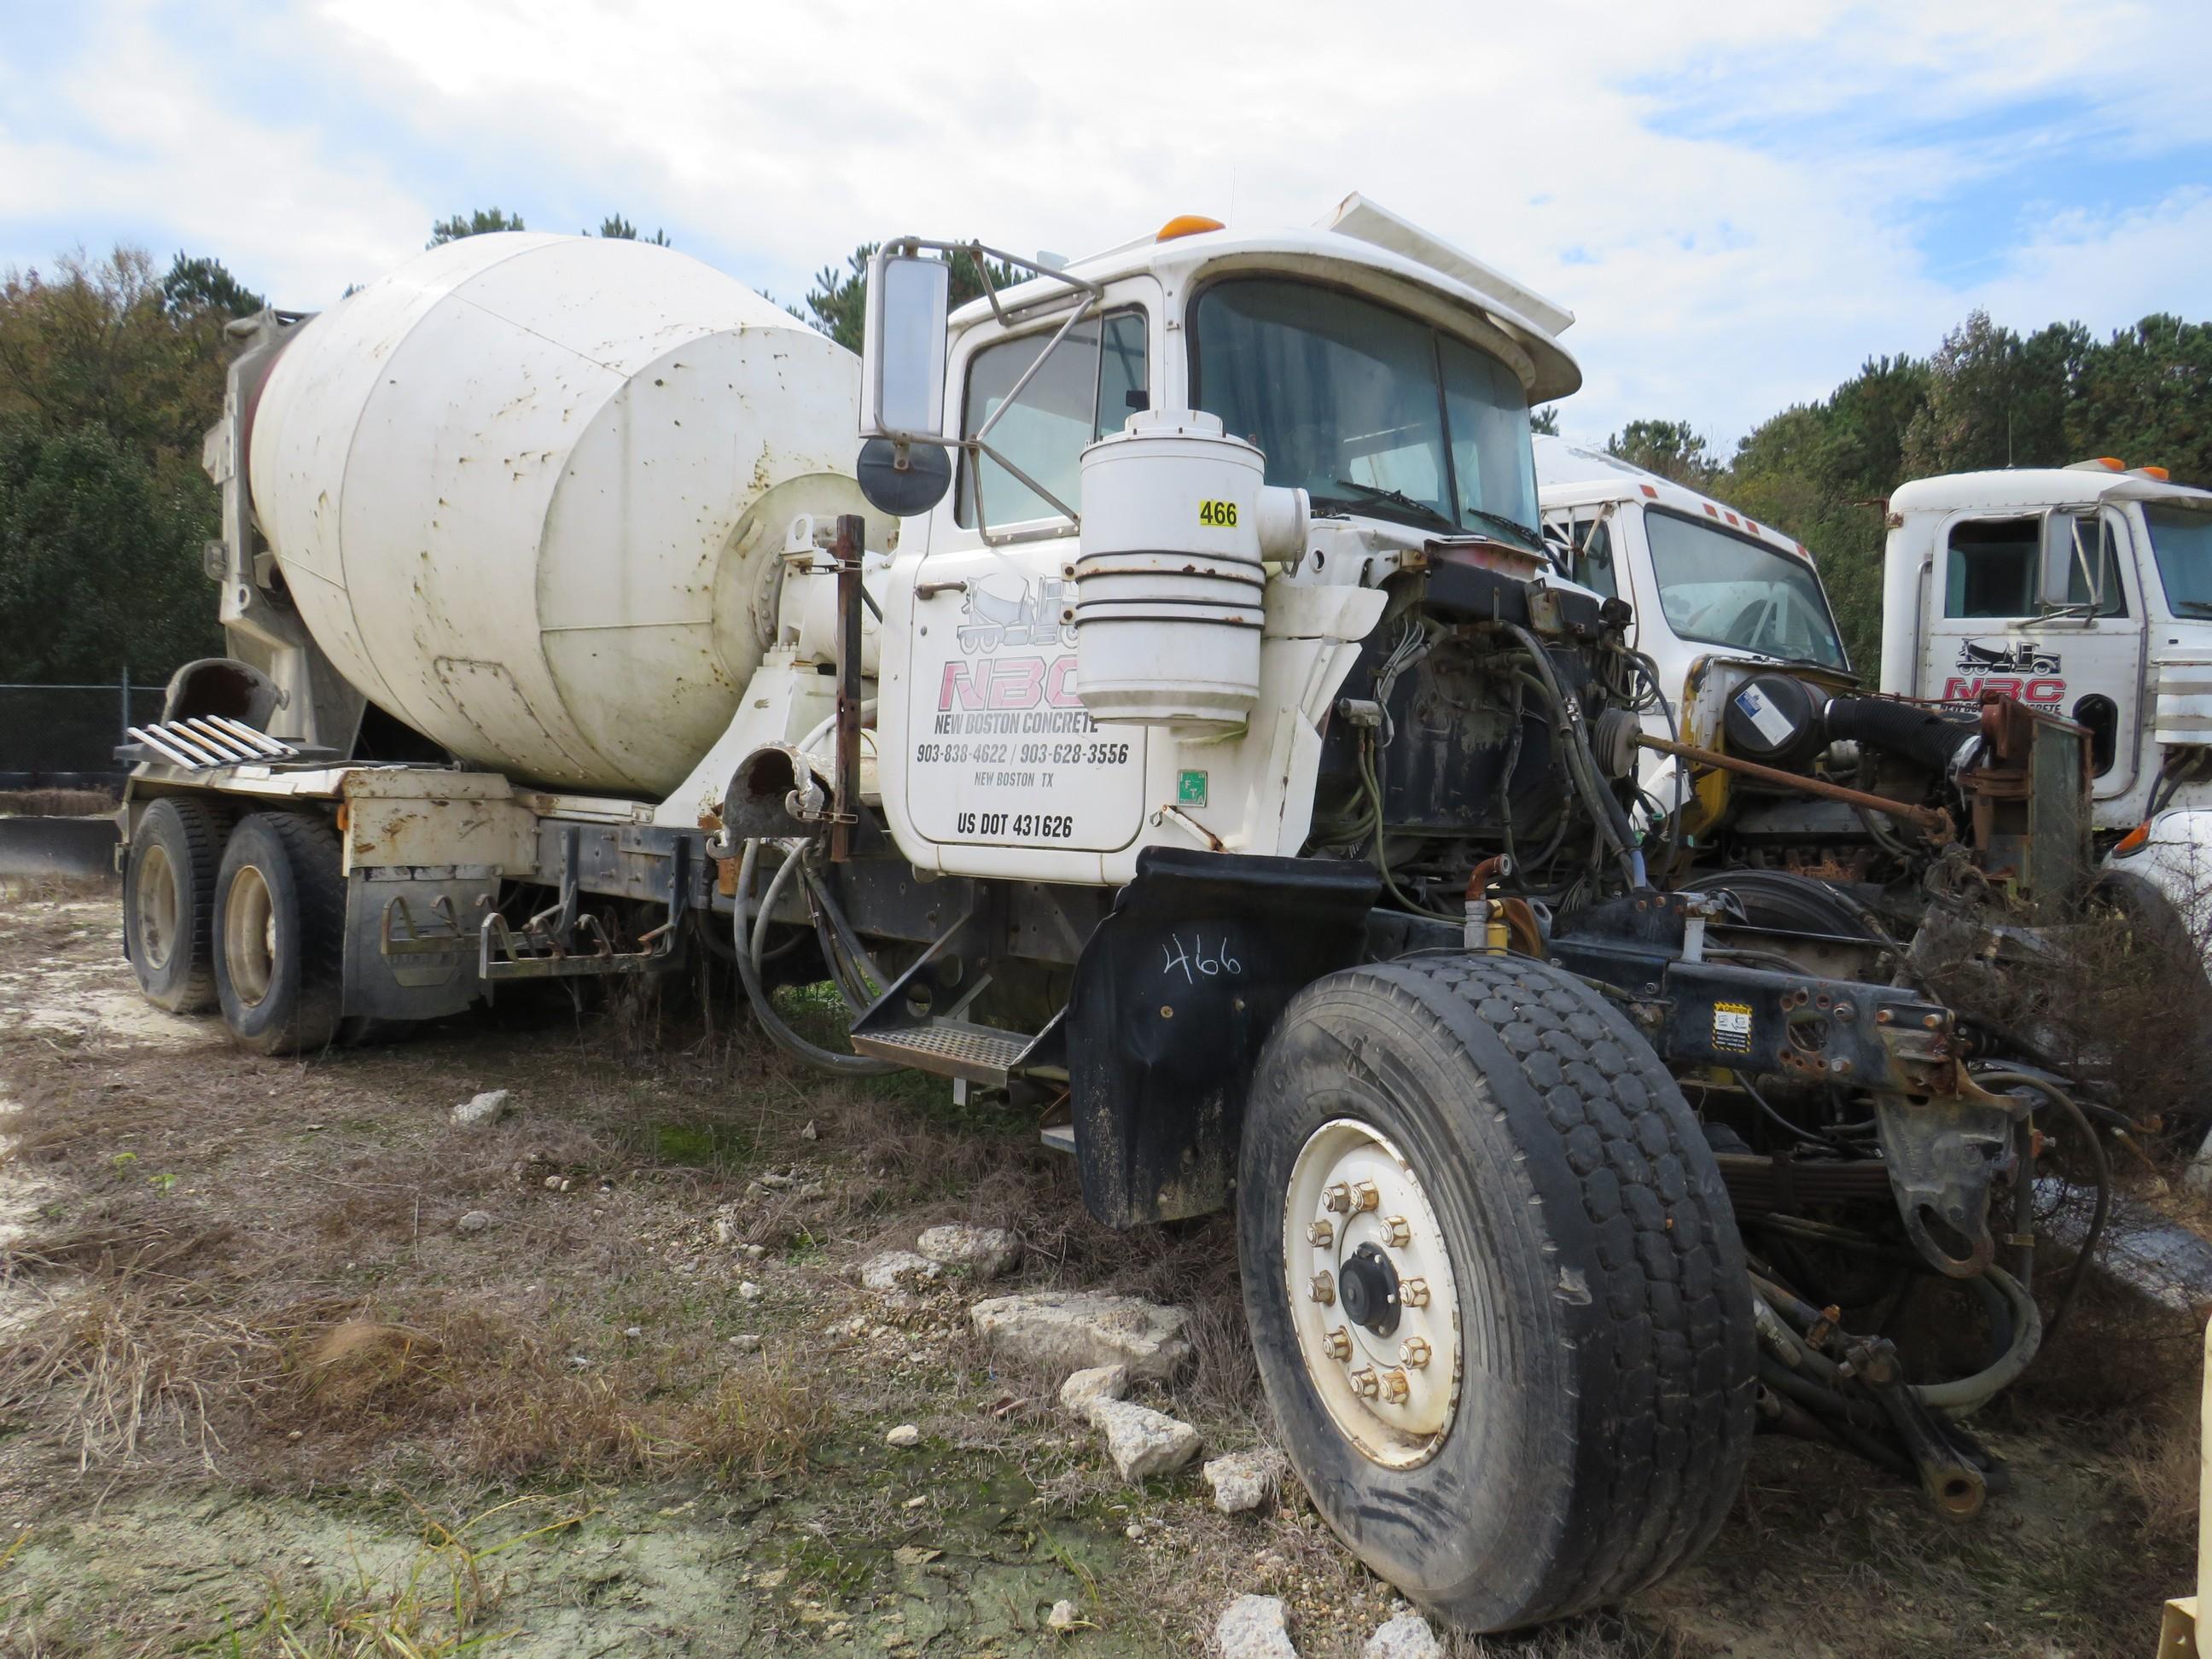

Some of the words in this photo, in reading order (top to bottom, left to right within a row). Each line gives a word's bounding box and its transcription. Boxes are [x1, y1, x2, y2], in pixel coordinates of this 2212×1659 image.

[1200, 501, 1237, 526] 466
[934, 713, 963, 735] NEW
[965, 712, 1019, 735] BOSTON
[1022, 711, 1098, 734] CONCRETE
[917, 743, 1007, 764] 903-838-4622
[1020, 743, 1129, 765] 903-628-3556
[975, 771, 993, 786] NEW
[996, 771, 1035, 788] BOSTON
[1042, 772, 1054, 788] TX
[958, 812, 975, 834] US
[981, 813, 1009, 835] DOT
[1013, 814, 1073, 838] 431626
[1162, 933, 1242, 985] 466
